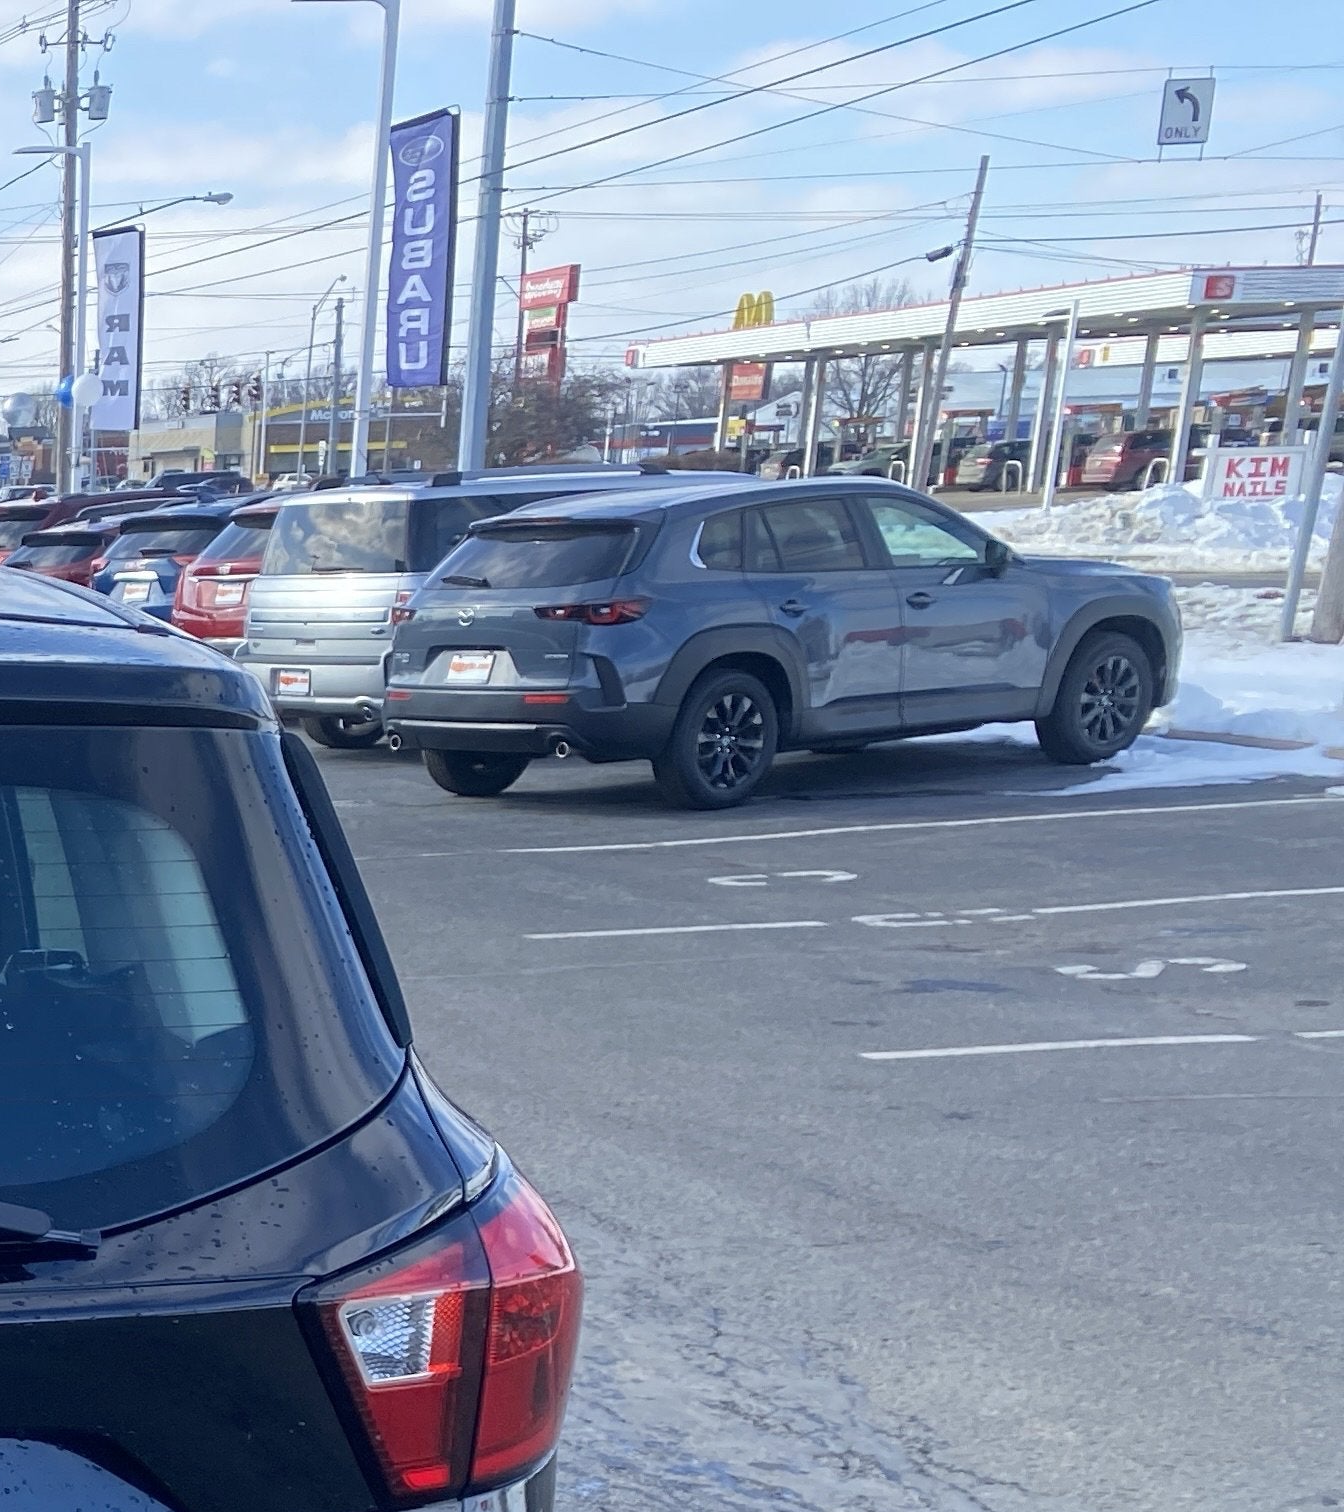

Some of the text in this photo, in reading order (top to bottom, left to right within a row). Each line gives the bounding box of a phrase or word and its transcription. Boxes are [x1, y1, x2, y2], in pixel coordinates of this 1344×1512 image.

[1164, 126, 1201, 139] ONLY
[1225, 456, 1291, 479] KIM
[1223, 480, 1287, 497] NAILS
